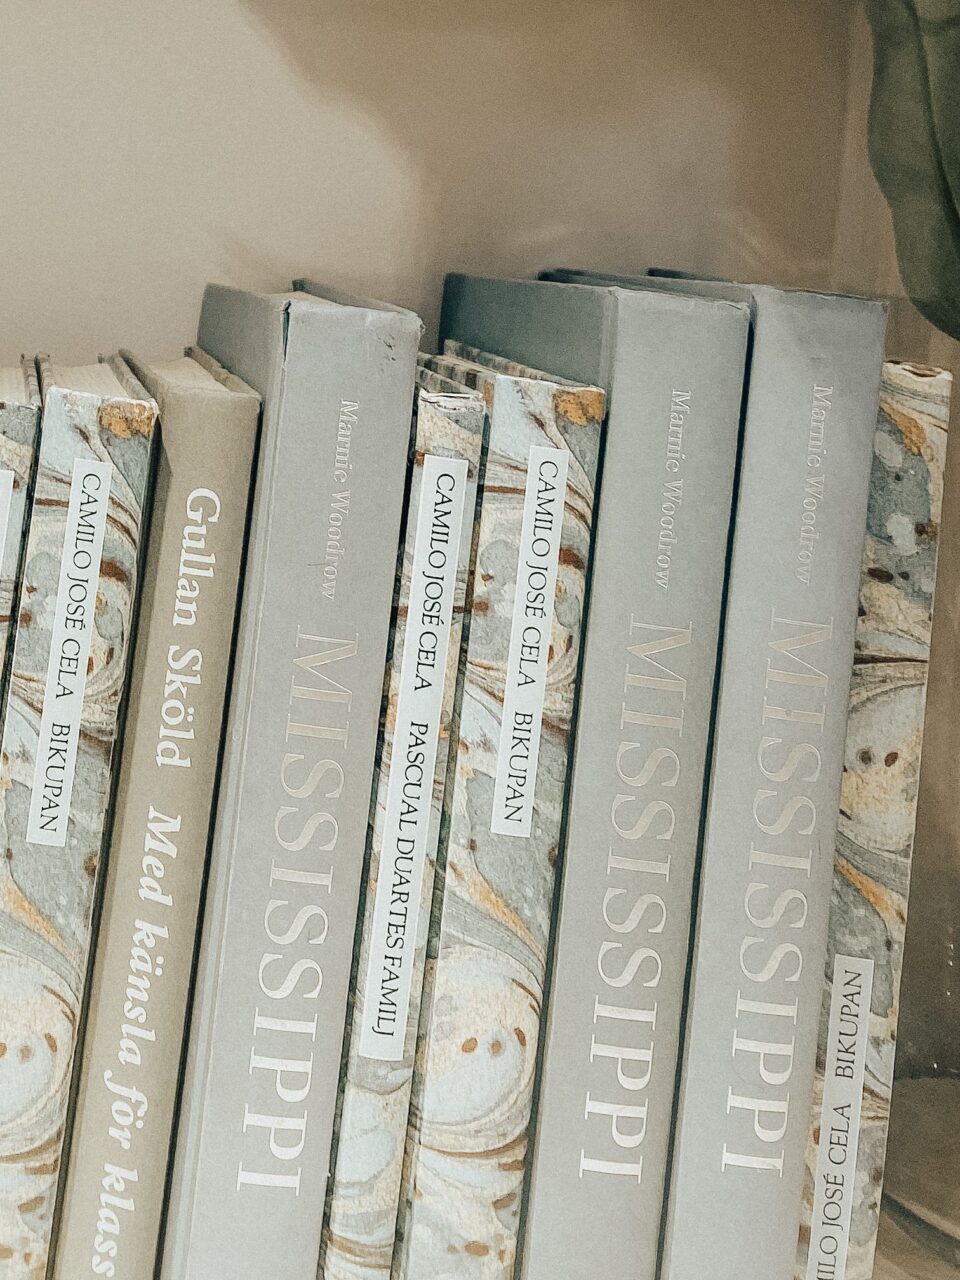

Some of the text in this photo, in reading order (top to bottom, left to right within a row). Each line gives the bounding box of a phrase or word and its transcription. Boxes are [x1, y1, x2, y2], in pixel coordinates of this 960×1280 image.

[39, 472, 101, 833] CAMILO JOSÉ CELA BIKUPAN
[320, 398, 360, 600] Marnie Woodrow
[503, 459, 559, 824] CAMILO JOSÉ CELA BIKUPAN
[654, 388, 692, 591] Marnie Woodrow
[796, 383, 834, 586] Marnie Woodrow
[91, 487, 221, 1278] Gullan Sköld Med känsla för klass
[236, 625, 360, 1197] MISSISSIPPI
[371, 472, 456, 1037] CAMILO JOSÉ CELA PASCUAL DUARTES FAMILJ
[578, 613, 695, 1185] MISSISSIPPI
[719, 607, 836, 1179] MISSISSIPPI
[816, 969, 863, 1280] ILO JOSÉ CELA BIKUPAN
